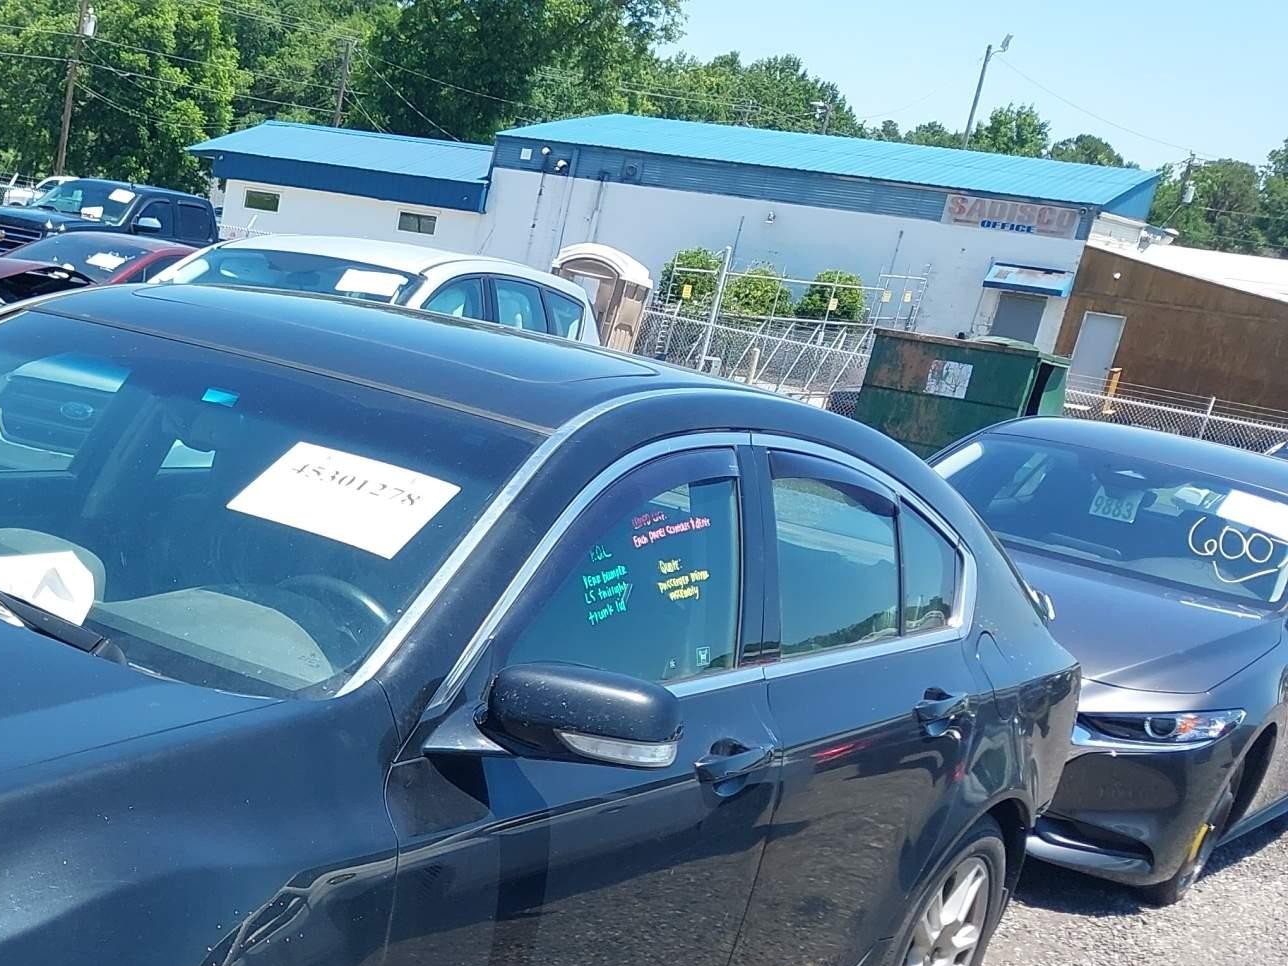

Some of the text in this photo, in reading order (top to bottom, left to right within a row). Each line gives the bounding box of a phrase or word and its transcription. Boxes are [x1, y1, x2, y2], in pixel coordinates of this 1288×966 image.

[949, 196, 1078, 229] SADISCO
[980, 219, 1035, 234] OFFICE
[291, 462, 422, 506] 45301278
